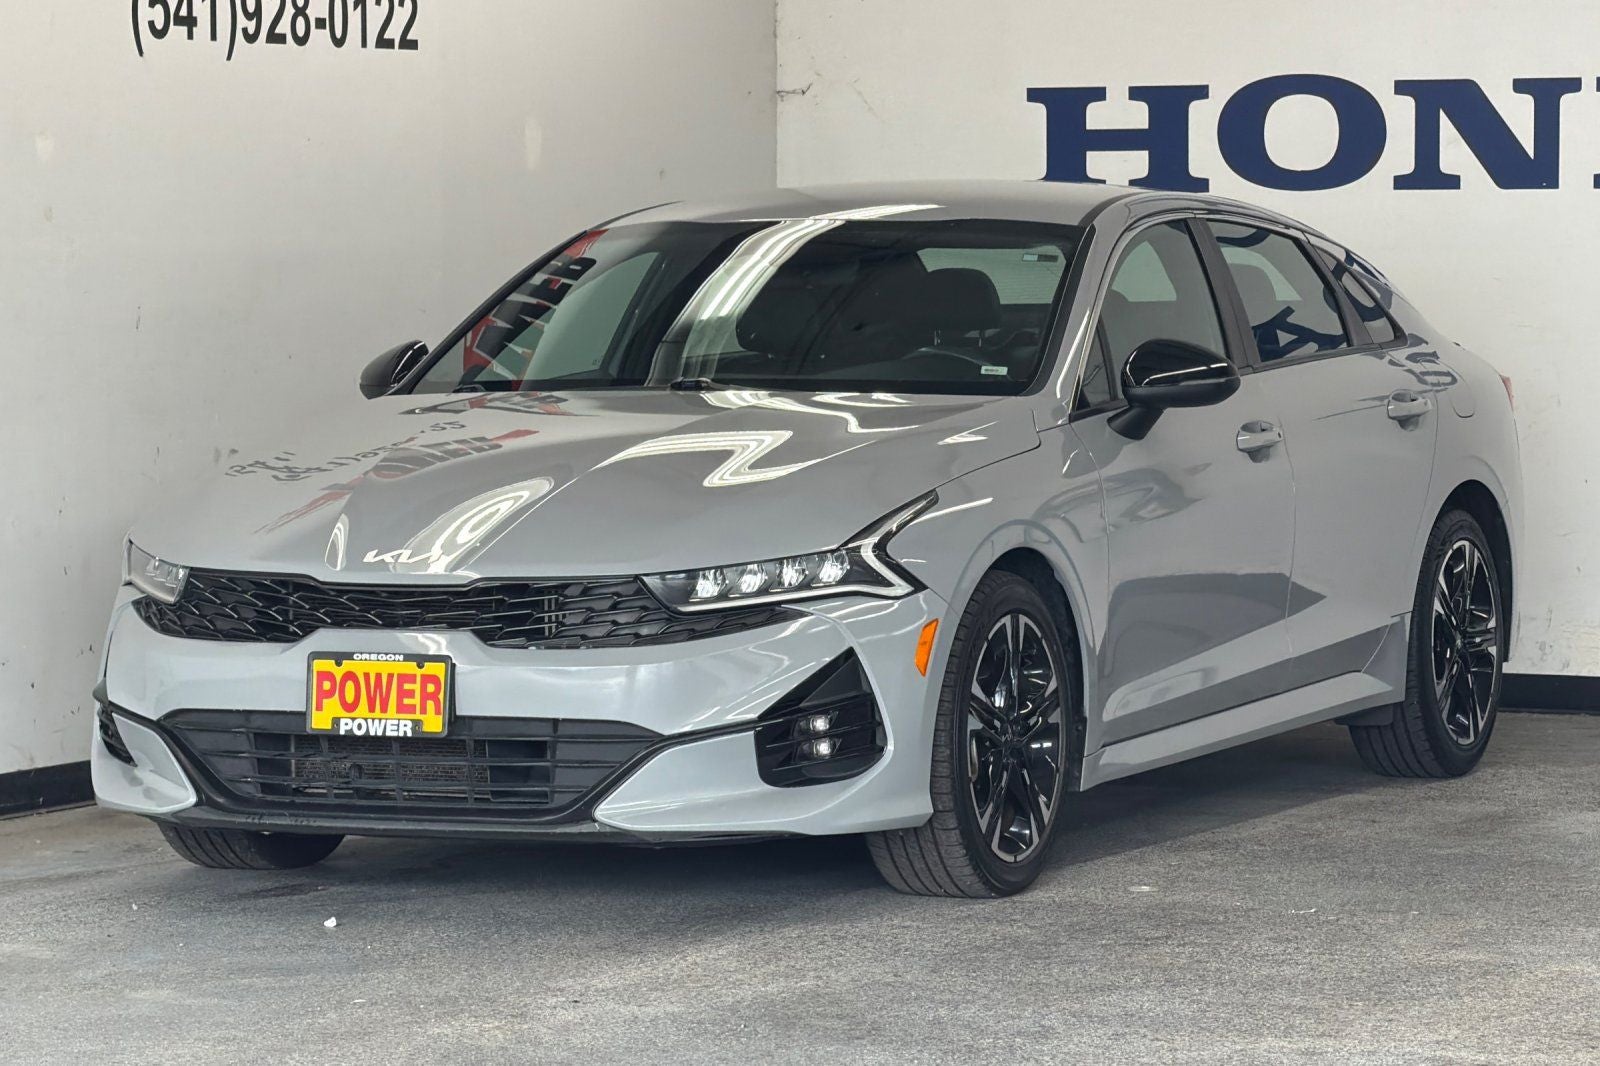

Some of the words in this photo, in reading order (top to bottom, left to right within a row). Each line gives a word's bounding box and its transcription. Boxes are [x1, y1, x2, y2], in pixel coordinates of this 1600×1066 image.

[1026, 73, 1600, 194] HON
[353, 653, 404, 662] OREGON
[315, 670, 443, 716] POWER
[339, 718, 413, 737] POWER
